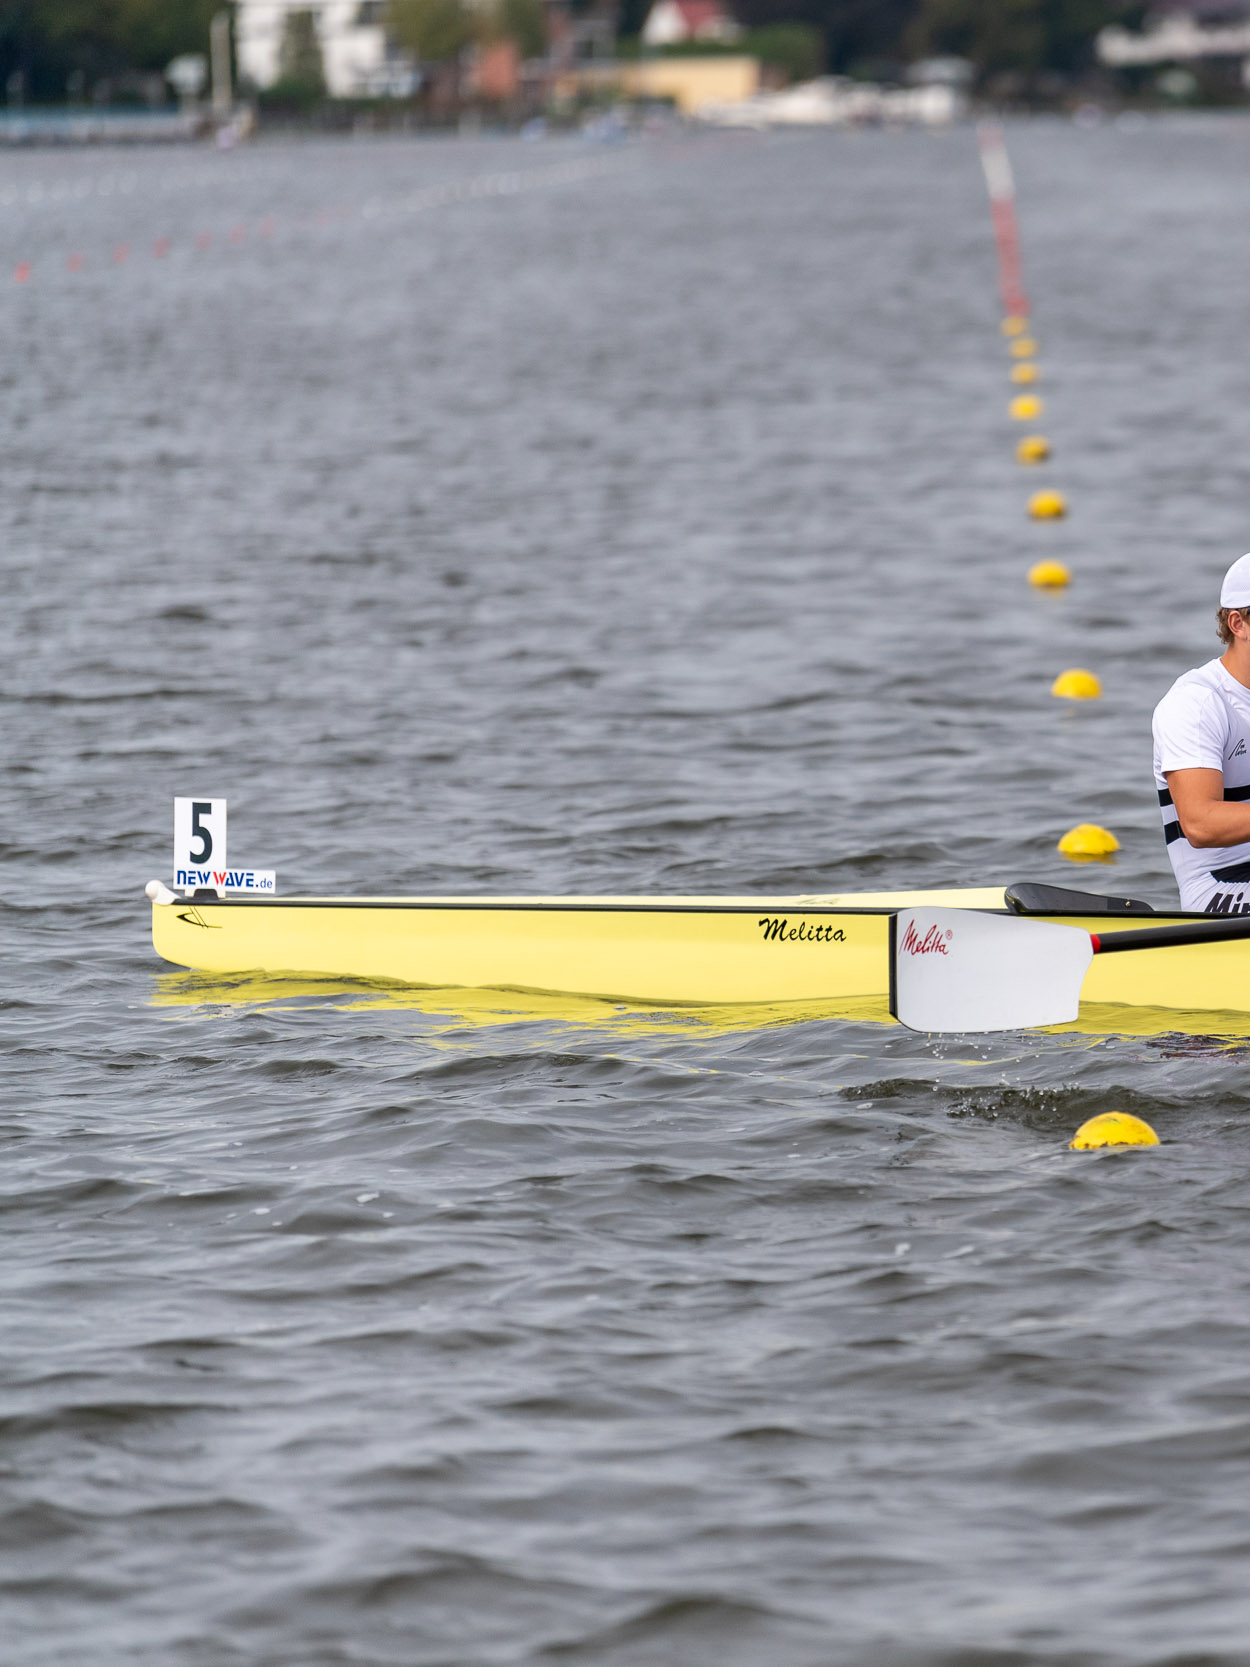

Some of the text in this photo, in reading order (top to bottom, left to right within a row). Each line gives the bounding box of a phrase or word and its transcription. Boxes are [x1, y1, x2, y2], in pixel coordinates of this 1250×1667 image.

[189, 801, 213, 865] 5
[177, 870, 273, 889] NEW WAVE.de
[758, 918, 847, 942] Melitta
[898, 919, 951, 956] Melitta
